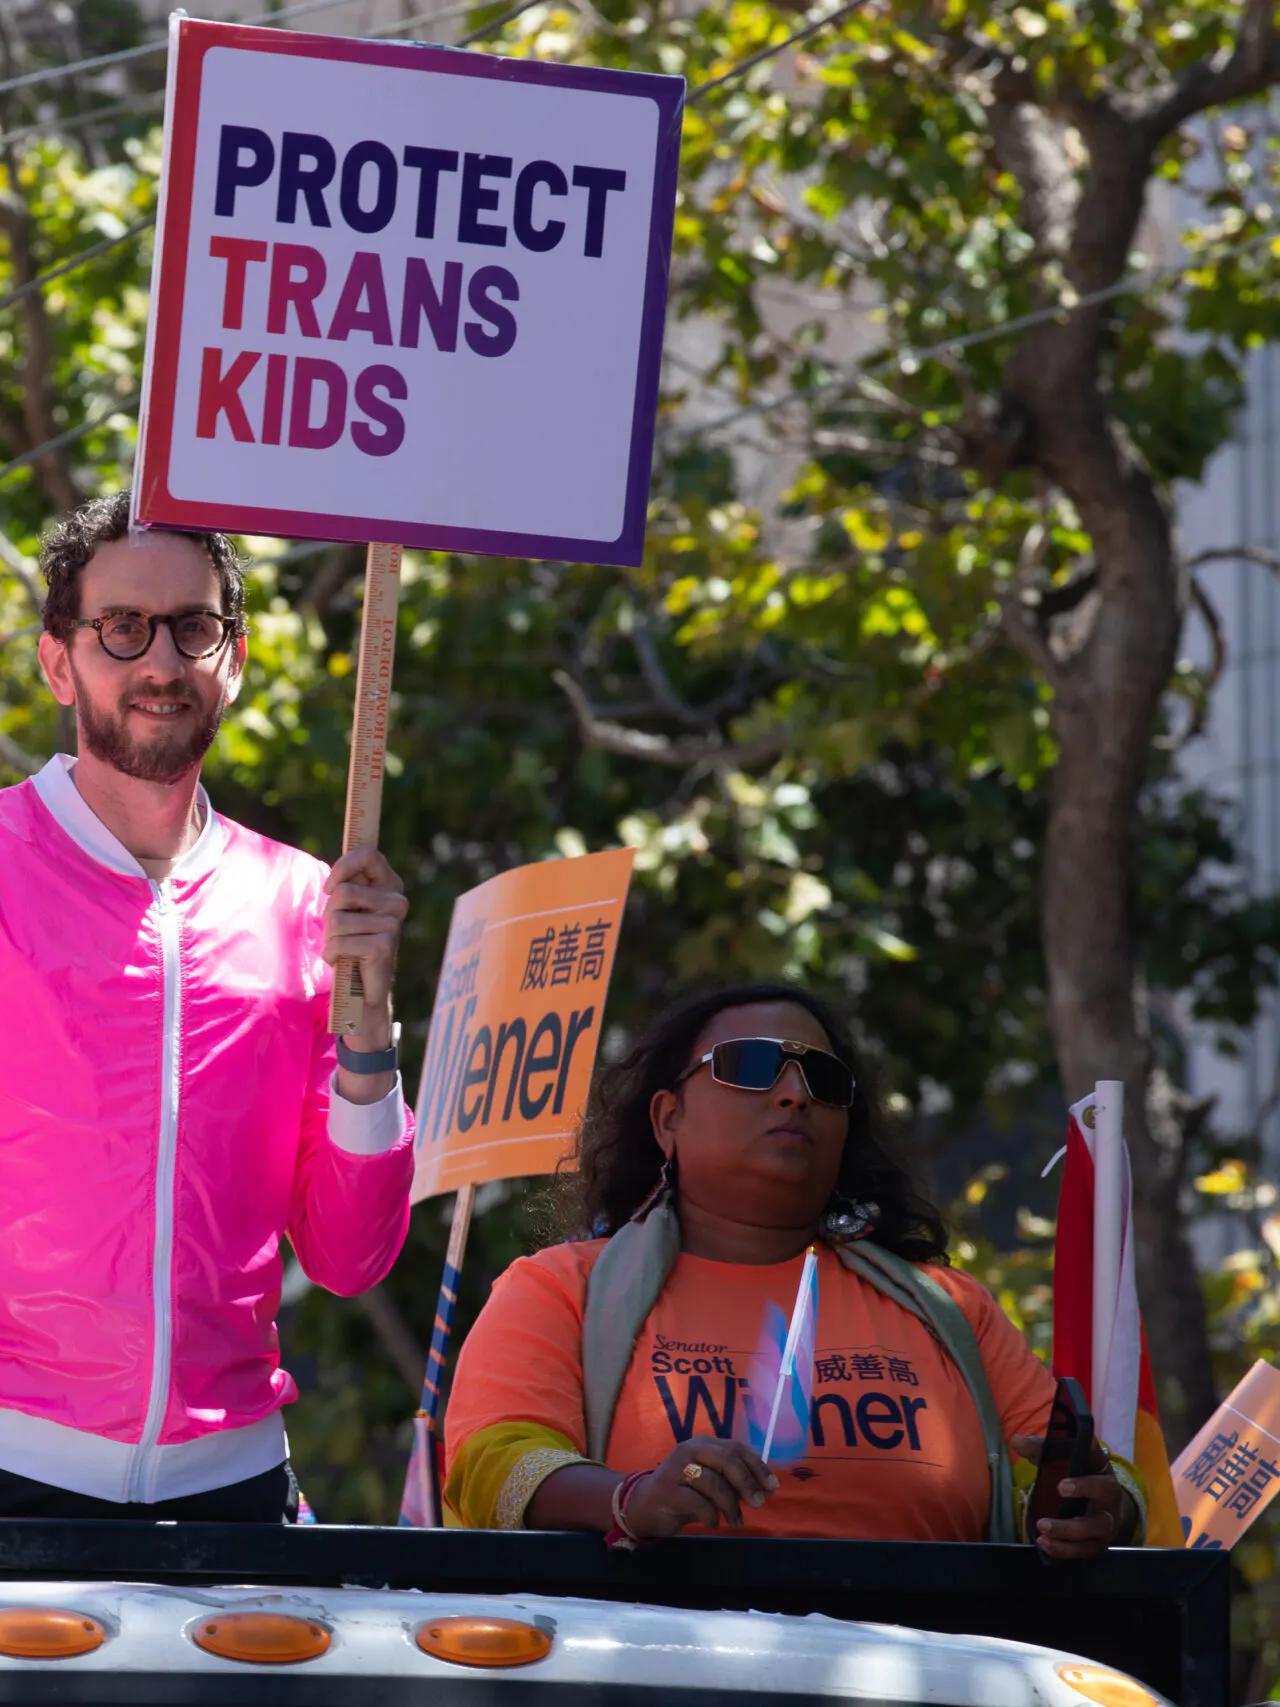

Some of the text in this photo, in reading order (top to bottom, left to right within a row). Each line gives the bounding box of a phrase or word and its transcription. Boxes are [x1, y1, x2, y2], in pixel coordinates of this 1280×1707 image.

[214, 124, 627, 258] PROTECT
[209, 235, 520, 358] TRANS
[196, 346, 408, 457] KIDS
[378, 617, 394, 677] DEPOT
[373, 682, 389, 740] HOME
[370, 744, 383, 782] THE
[520, 917, 612, 992] 威善高
[416, 996, 596, 1150] Wiener
[651, 1351, 736, 1375] Scott
[652, 1333, 729, 1354] Senator
[815, 1353, 920, 1386] 威善高
[654, 1375, 927, 1451] Winer
